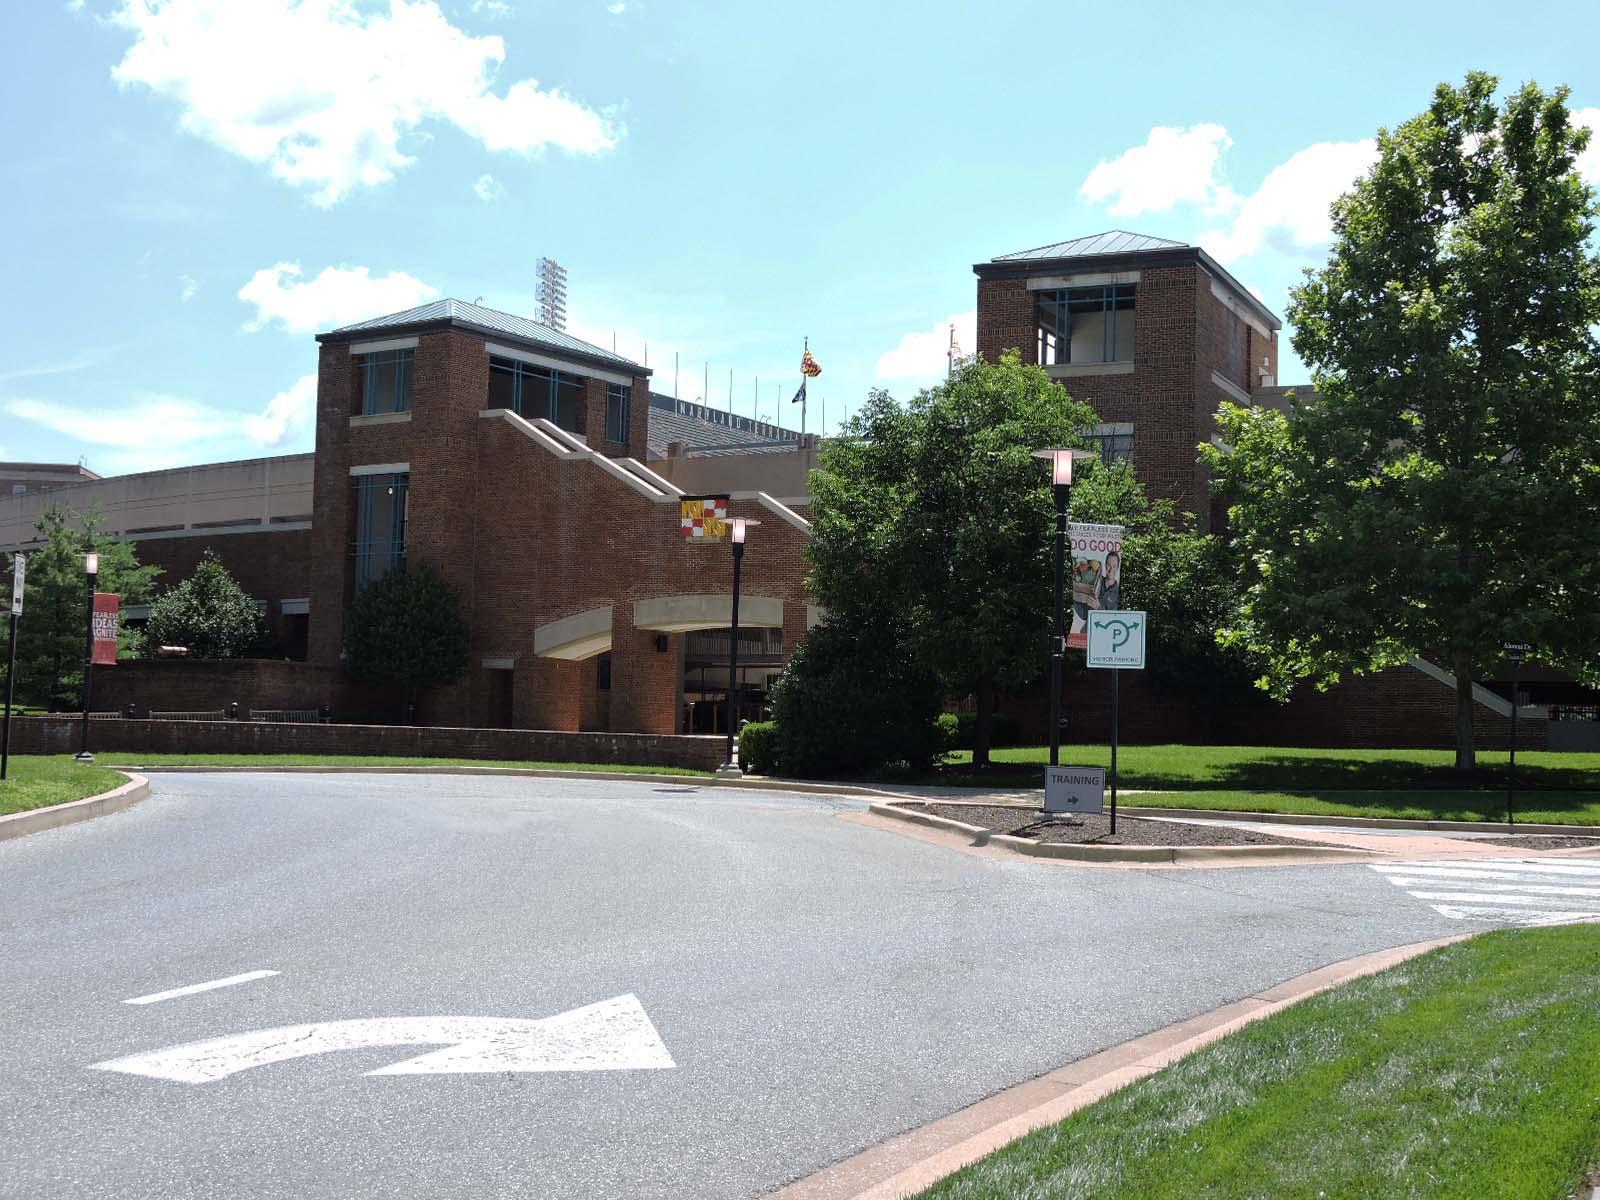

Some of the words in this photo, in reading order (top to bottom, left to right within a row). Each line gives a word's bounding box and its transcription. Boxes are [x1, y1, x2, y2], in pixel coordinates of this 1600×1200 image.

[1070, 539, 1087, 552] DO
[1089, 539, 1122, 553] GOOD
[1113, 628, 1122, 639] P
[1114, 656, 1139, 664] PARKING
[1051, 774, 1100, 786] TRAINING
